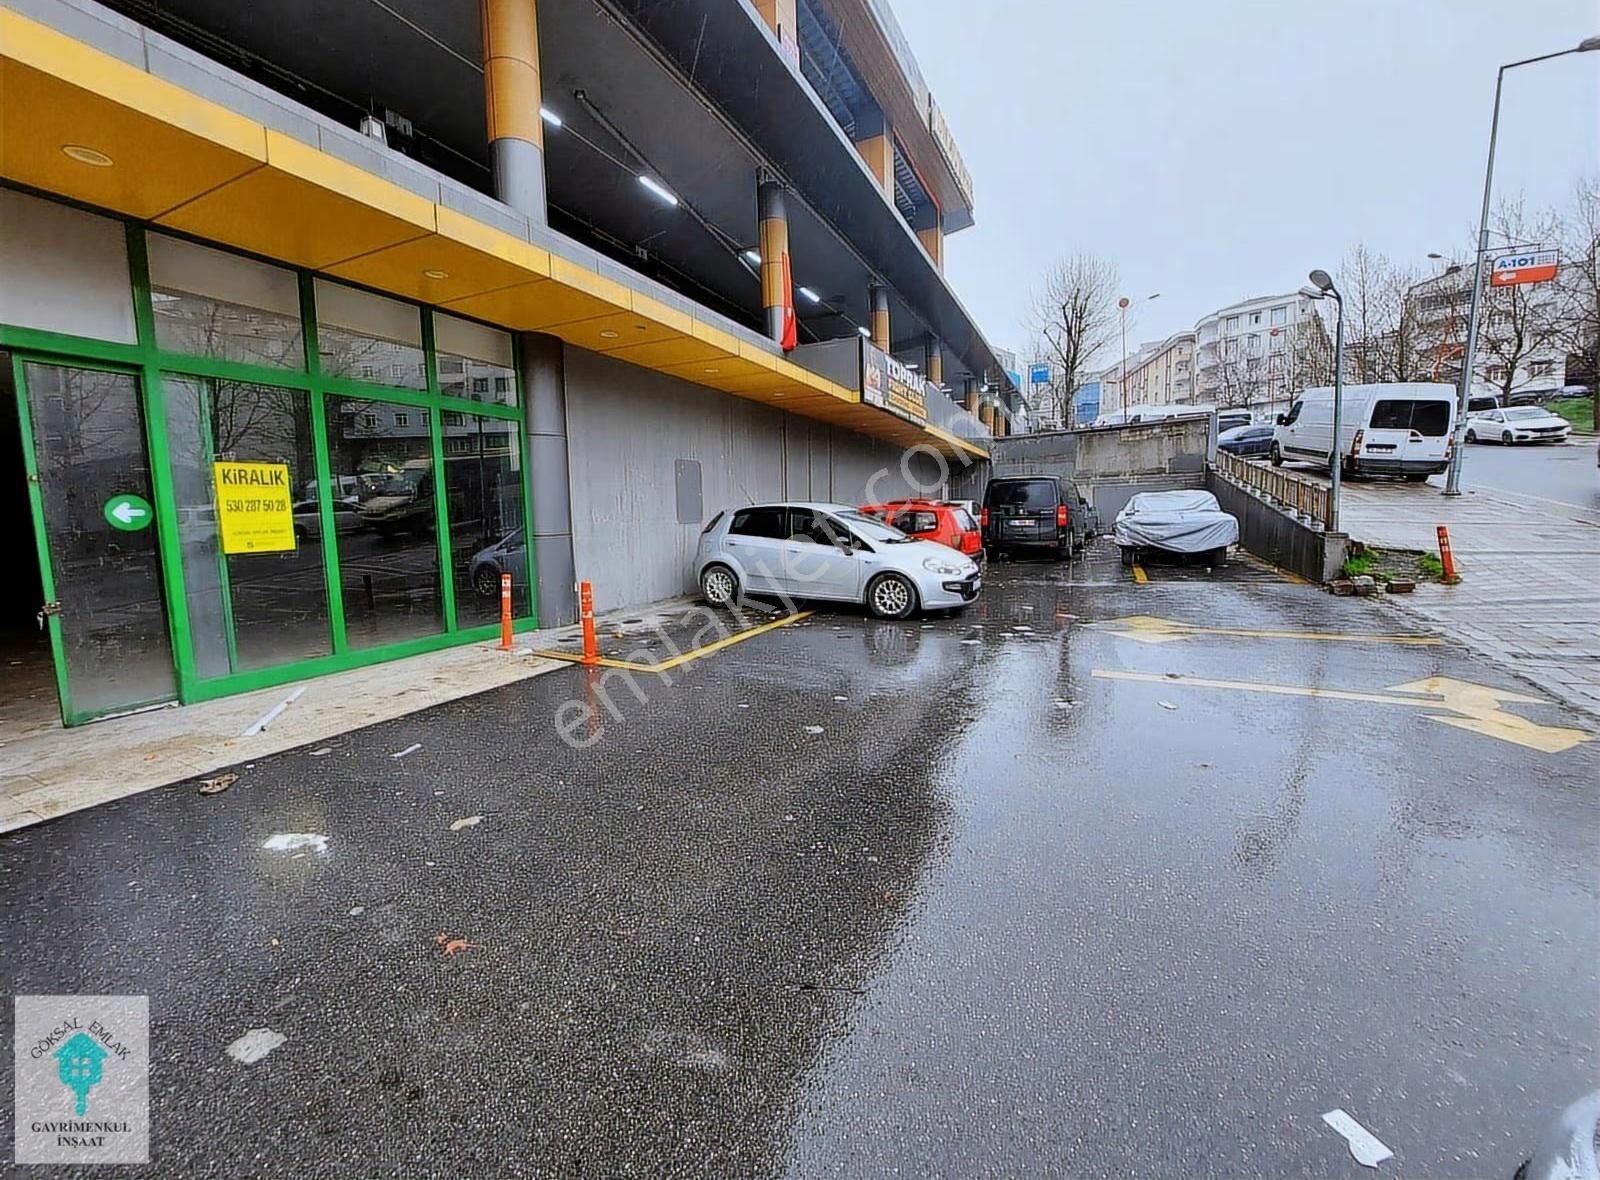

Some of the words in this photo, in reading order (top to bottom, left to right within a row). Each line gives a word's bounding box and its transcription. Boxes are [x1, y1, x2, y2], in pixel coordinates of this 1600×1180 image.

[885, 354, 926, 397] TOPRAK
[226, 499, 244, 512] 530
[245, 499, 261, 512] 287
[262, 499, 274, 512] 50
[275, 498, 287, 512] 28
